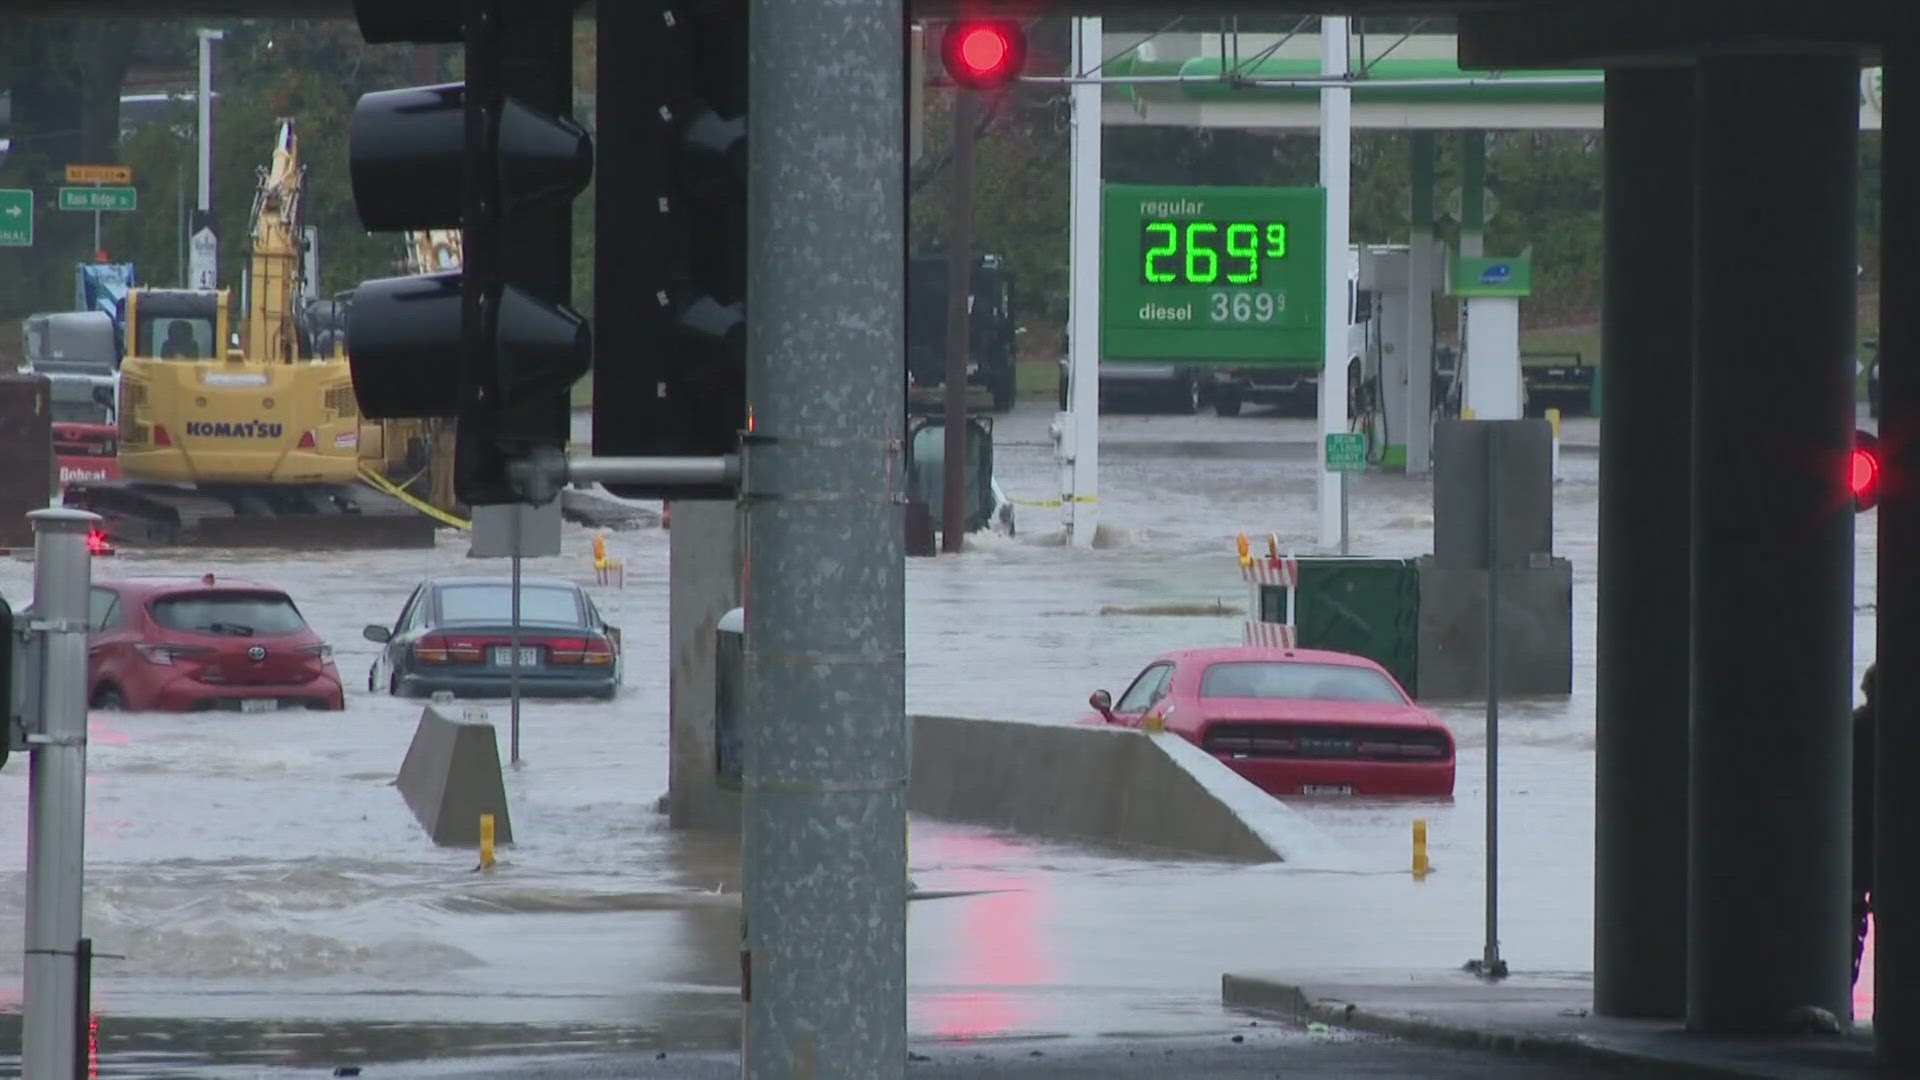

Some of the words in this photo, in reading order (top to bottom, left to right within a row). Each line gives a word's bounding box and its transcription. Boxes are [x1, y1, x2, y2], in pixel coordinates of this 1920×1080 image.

[1140, 199, 1204, 217] regular
[1139, 303, 1192, 320] diesel
[186, 420, 282, 438] KOMATSU
[60, 466, 106, 481] Bobcat
